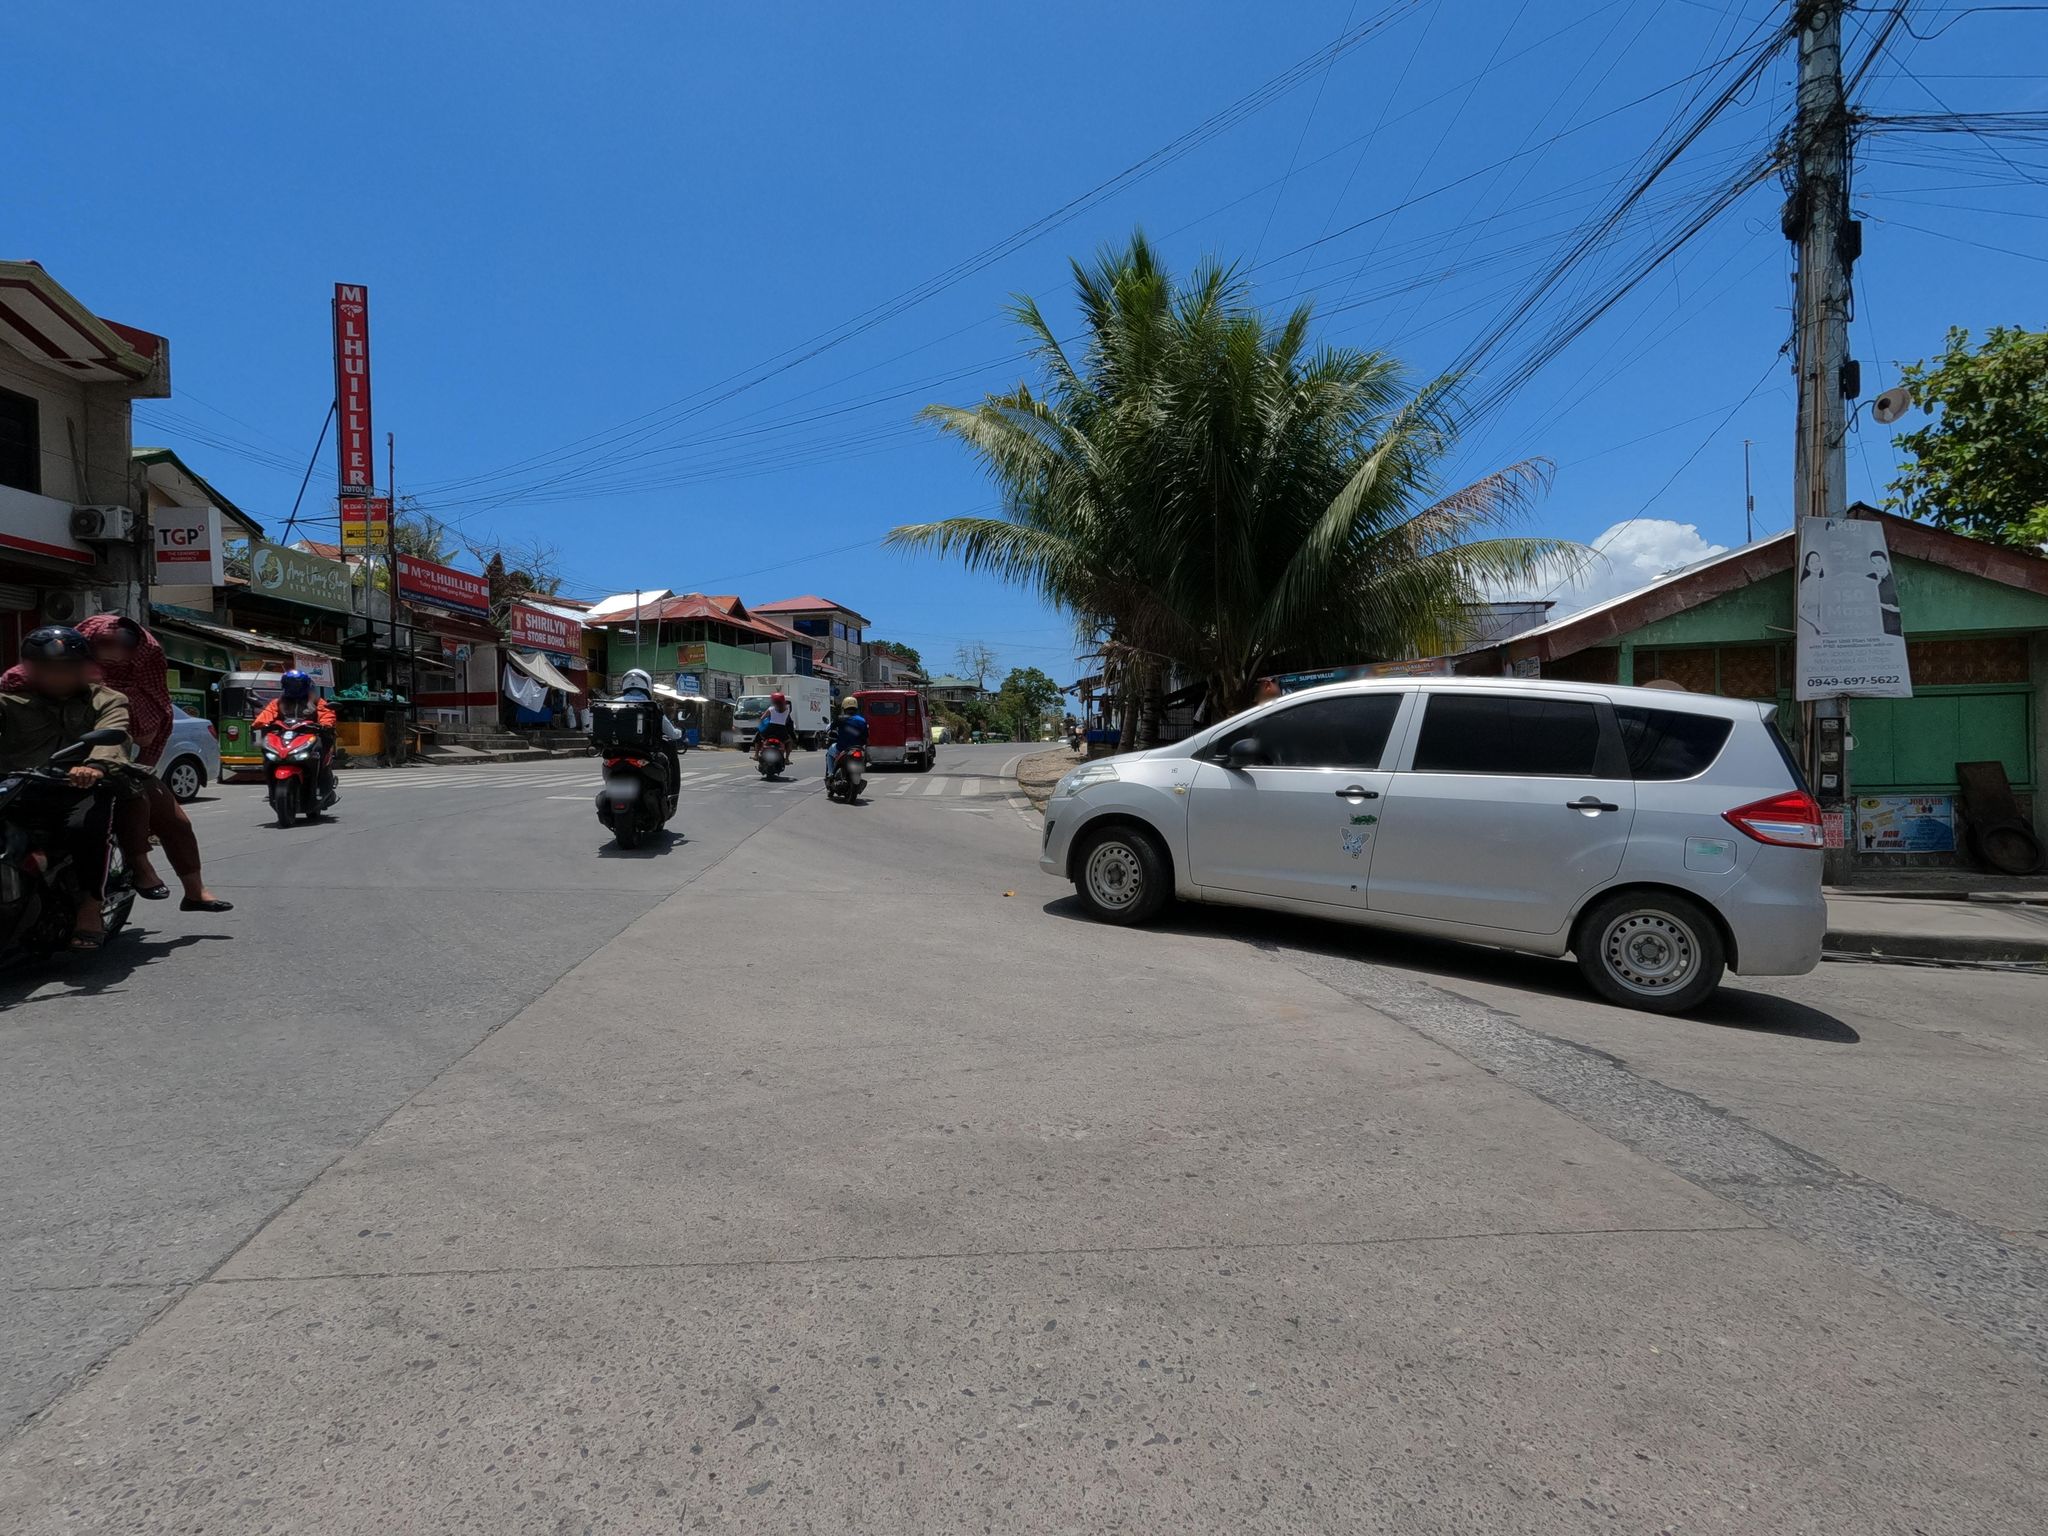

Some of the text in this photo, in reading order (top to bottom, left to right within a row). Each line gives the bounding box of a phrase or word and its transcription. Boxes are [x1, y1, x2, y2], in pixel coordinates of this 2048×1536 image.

[159, 528, 199, 545] TGP
[525, 613, 566, 635] SHIRILYN
[527, 630, 547, 643] STORE
[1807, 676, 1901, 687] 0949-697-5622
